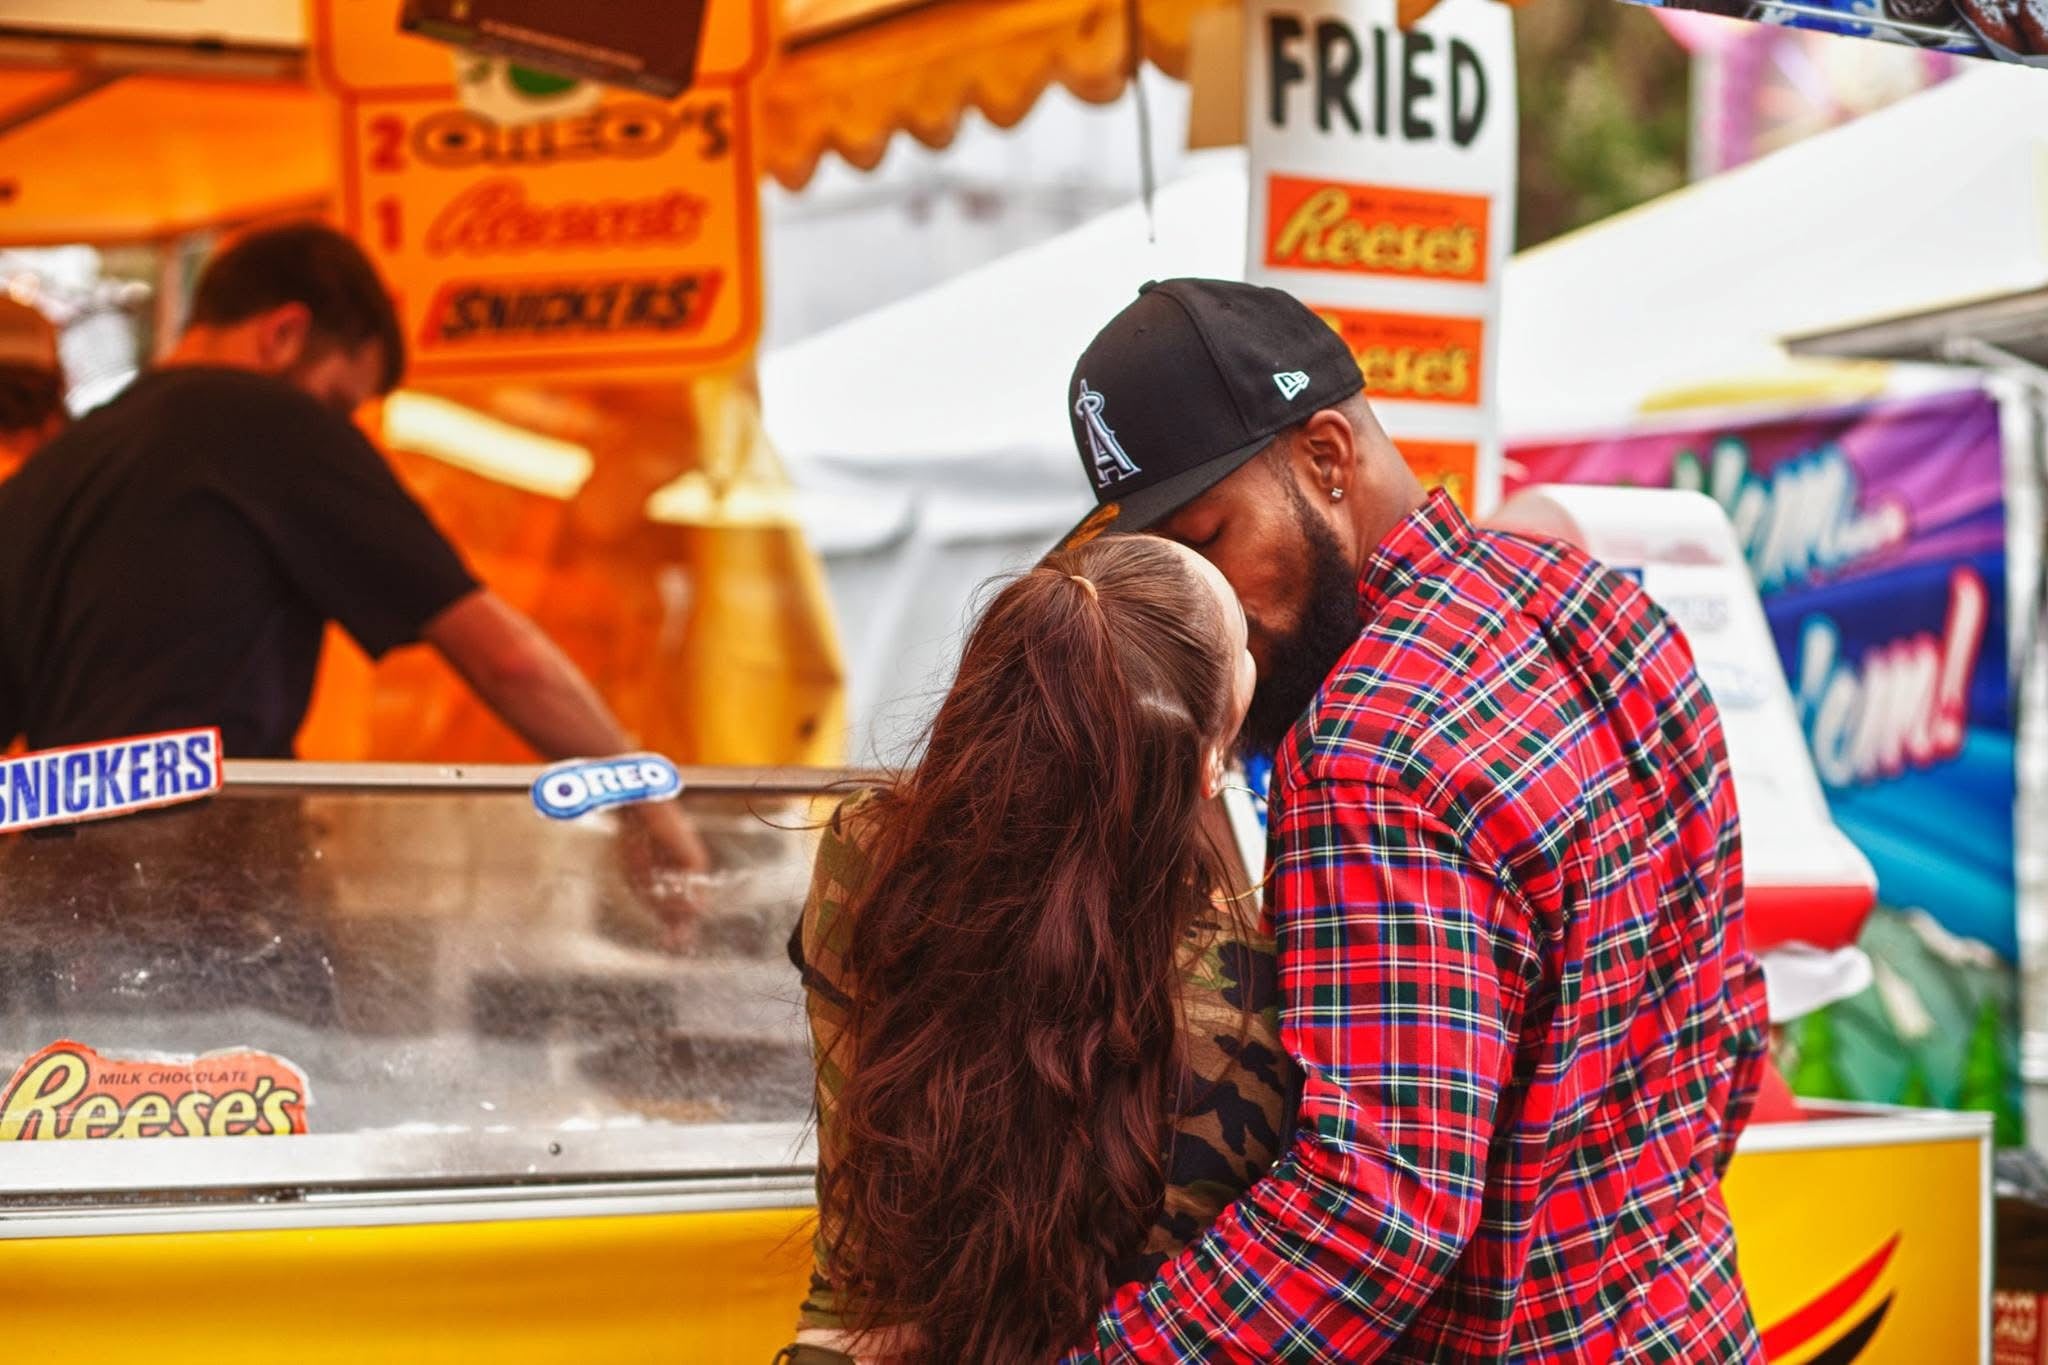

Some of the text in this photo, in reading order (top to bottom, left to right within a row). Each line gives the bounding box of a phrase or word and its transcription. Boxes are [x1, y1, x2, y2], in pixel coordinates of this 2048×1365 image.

[1267, 13, 1488, 147] FRIED
[369, 116, 405, 173] 2
[378, 195, 402, 253] 1
[1275, 184, 1478, 274] Reese's
[440, 276, 701, 340] SNICKERS
[0, 734, 212, 825] NICKERS
[543, 761, 670, 808] OREO
[0, 1050, 302, 1141] Reese's
[98, 1070, 249, 1086] MILK CHOCOLATE
